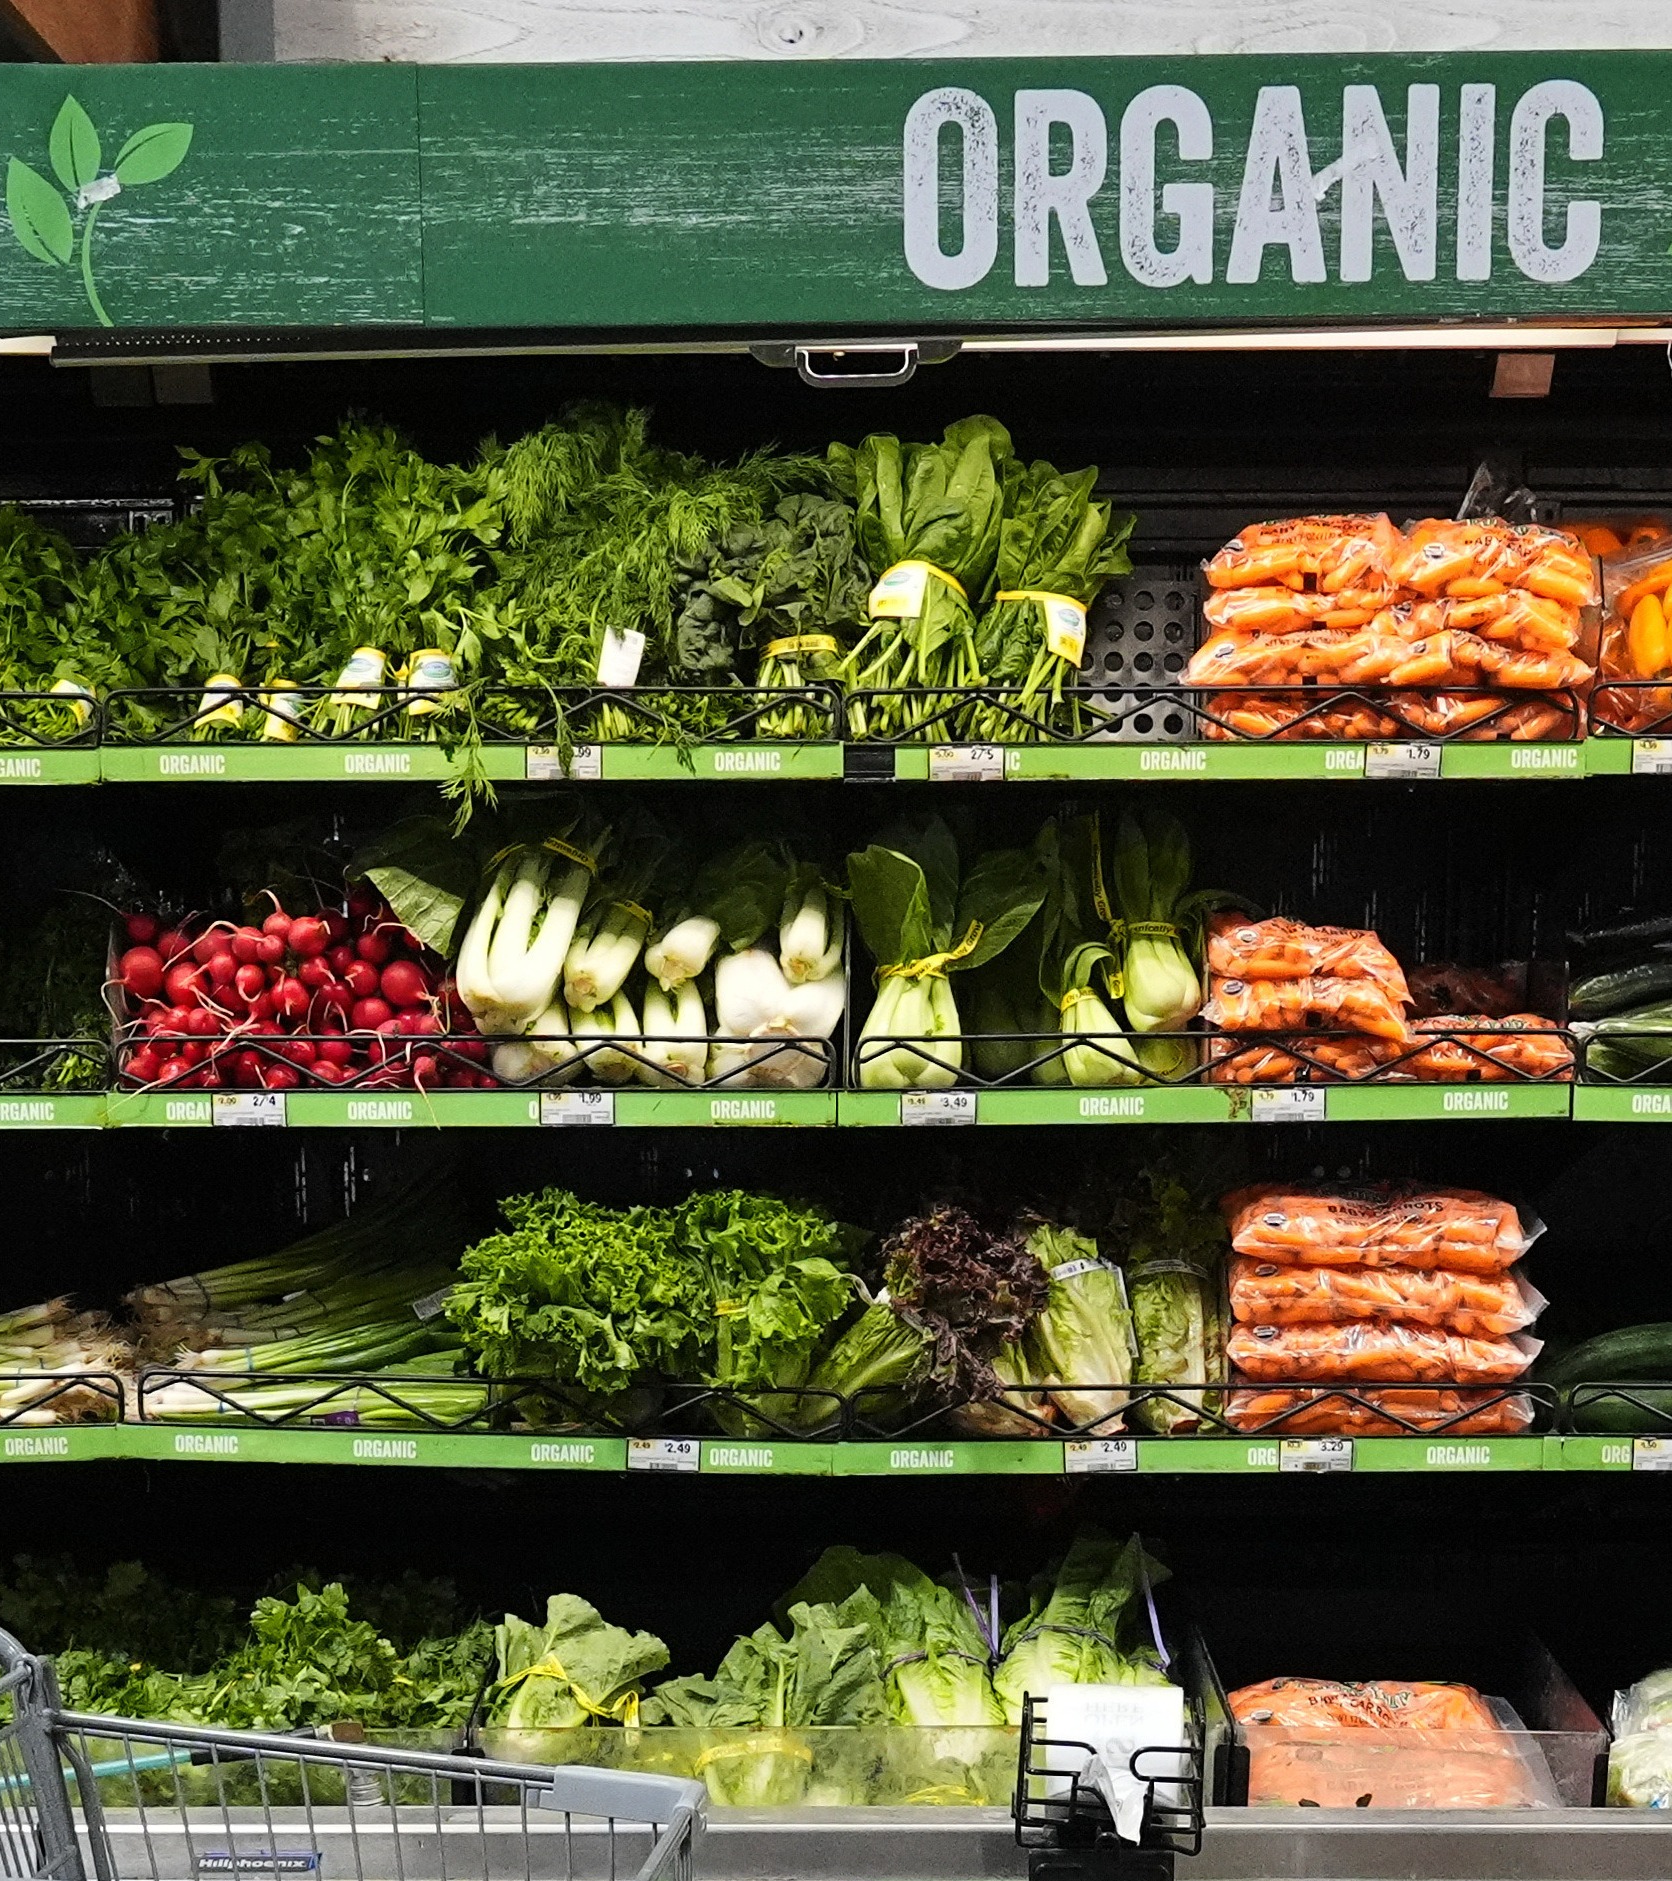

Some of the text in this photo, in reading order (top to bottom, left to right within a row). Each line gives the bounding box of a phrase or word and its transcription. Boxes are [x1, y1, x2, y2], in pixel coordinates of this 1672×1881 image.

[903, 79, 1605, 291] ORGANIC
[159, 755, 225, 774] ORGANIC
[345, 754, 410, 773] ORGANIC
[714, 752, 781, 771] ORGANIC
[1140, 751, 1206, 770] ORGANIC
[1325, 751, 1364, 769] ORGA
[1511, 749, 1577, 768] ORGANIC
[347, 1101, 412, 1120] ORGANIC
[710, 1100, 776, 1119] ORGANIC
[1079, 1097, 1144, 1116] ORGANIC
[1443, 1091, 1509, 1111] ORGANIC
[4, 1437, 68, 1455] ORGANIC
[174, 1435, 239, 1453] ORGANIC
[353, 1439, 417, 1458] ORGANIC
[530, 1444, 594, 1462] ORGANIC
[709, 1448, 773, 1467] ORGANIC
[890, 1450, 954, 1468] ORGANIC
[1426, 1446, 1490, 1465] ORGANIC
